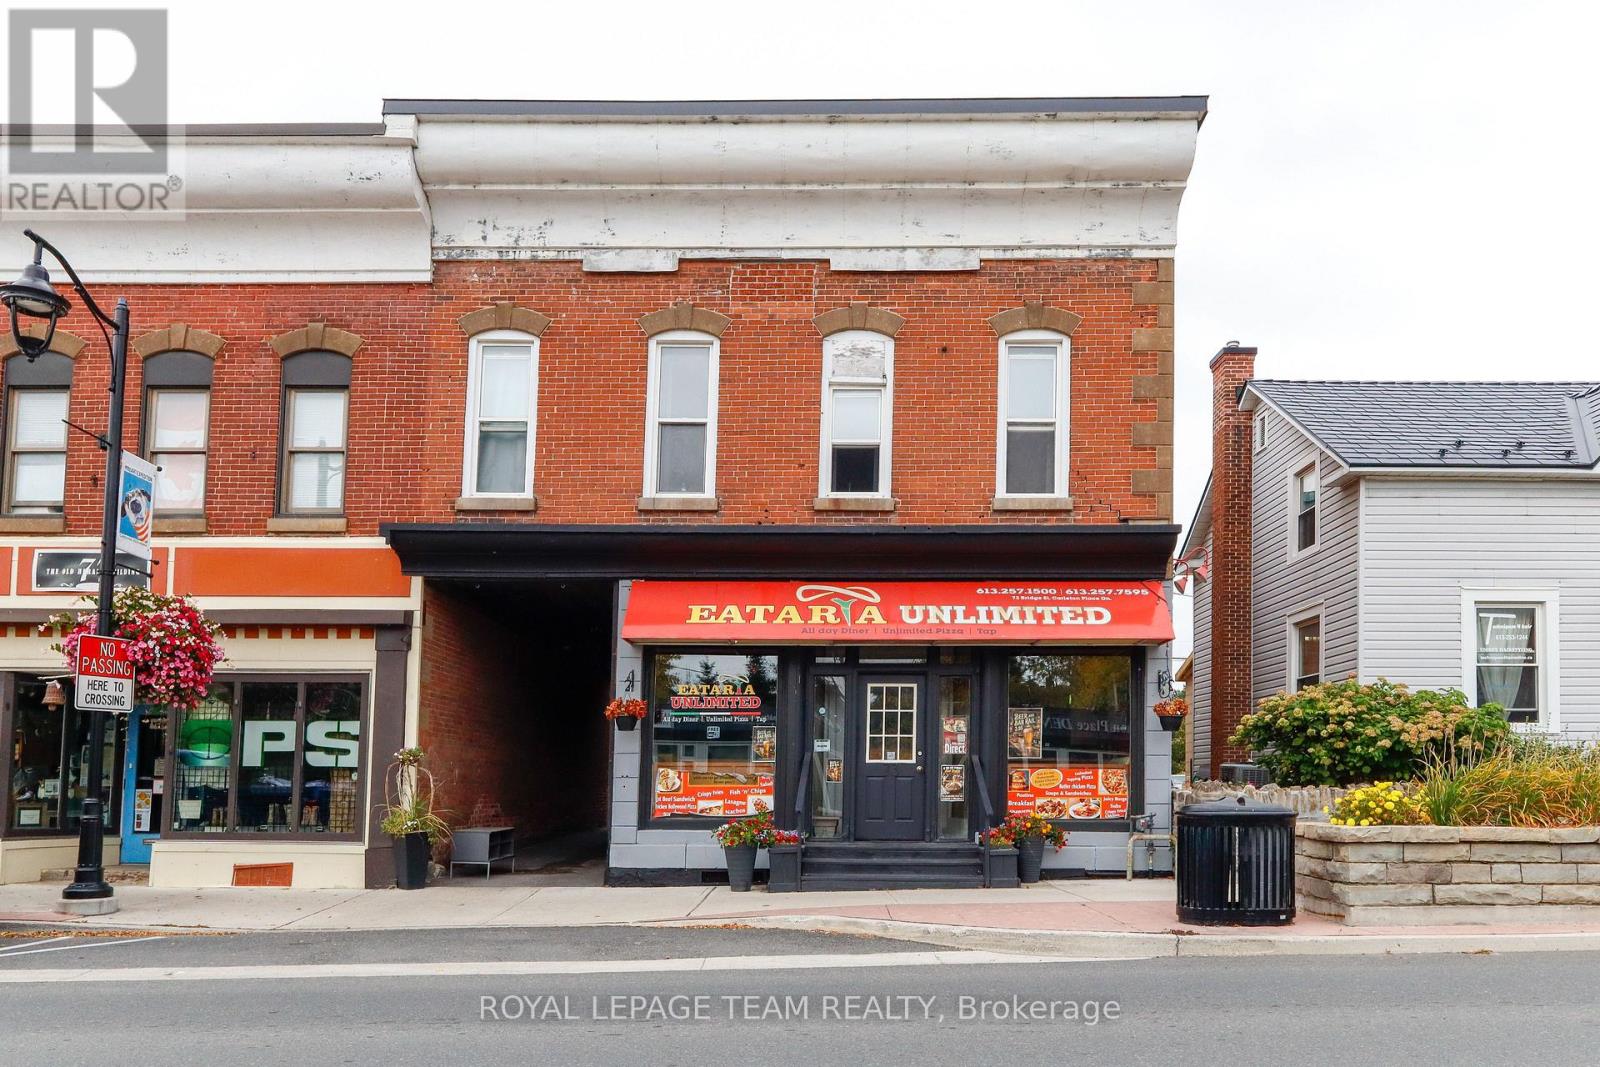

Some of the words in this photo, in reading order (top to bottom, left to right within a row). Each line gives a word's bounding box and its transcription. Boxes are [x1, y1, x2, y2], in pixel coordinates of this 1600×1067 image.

[976, 587, 1057, 595] 613.257.1500
[1066, 588, 1149, 596] 613.257.7595
[900, 605, 1112, 625] UNLIMITED
[818, 627, 838, 635] day
[100, 641, 116, 657] NO
[82, 656, 131, 676] PASSING
[87, 679, 108, 692] HERE
[114, 681, 124, 692] TO
[85, 693, 125, 706] CROSSING
[671, 696, 762, 709] UNLIMITED
